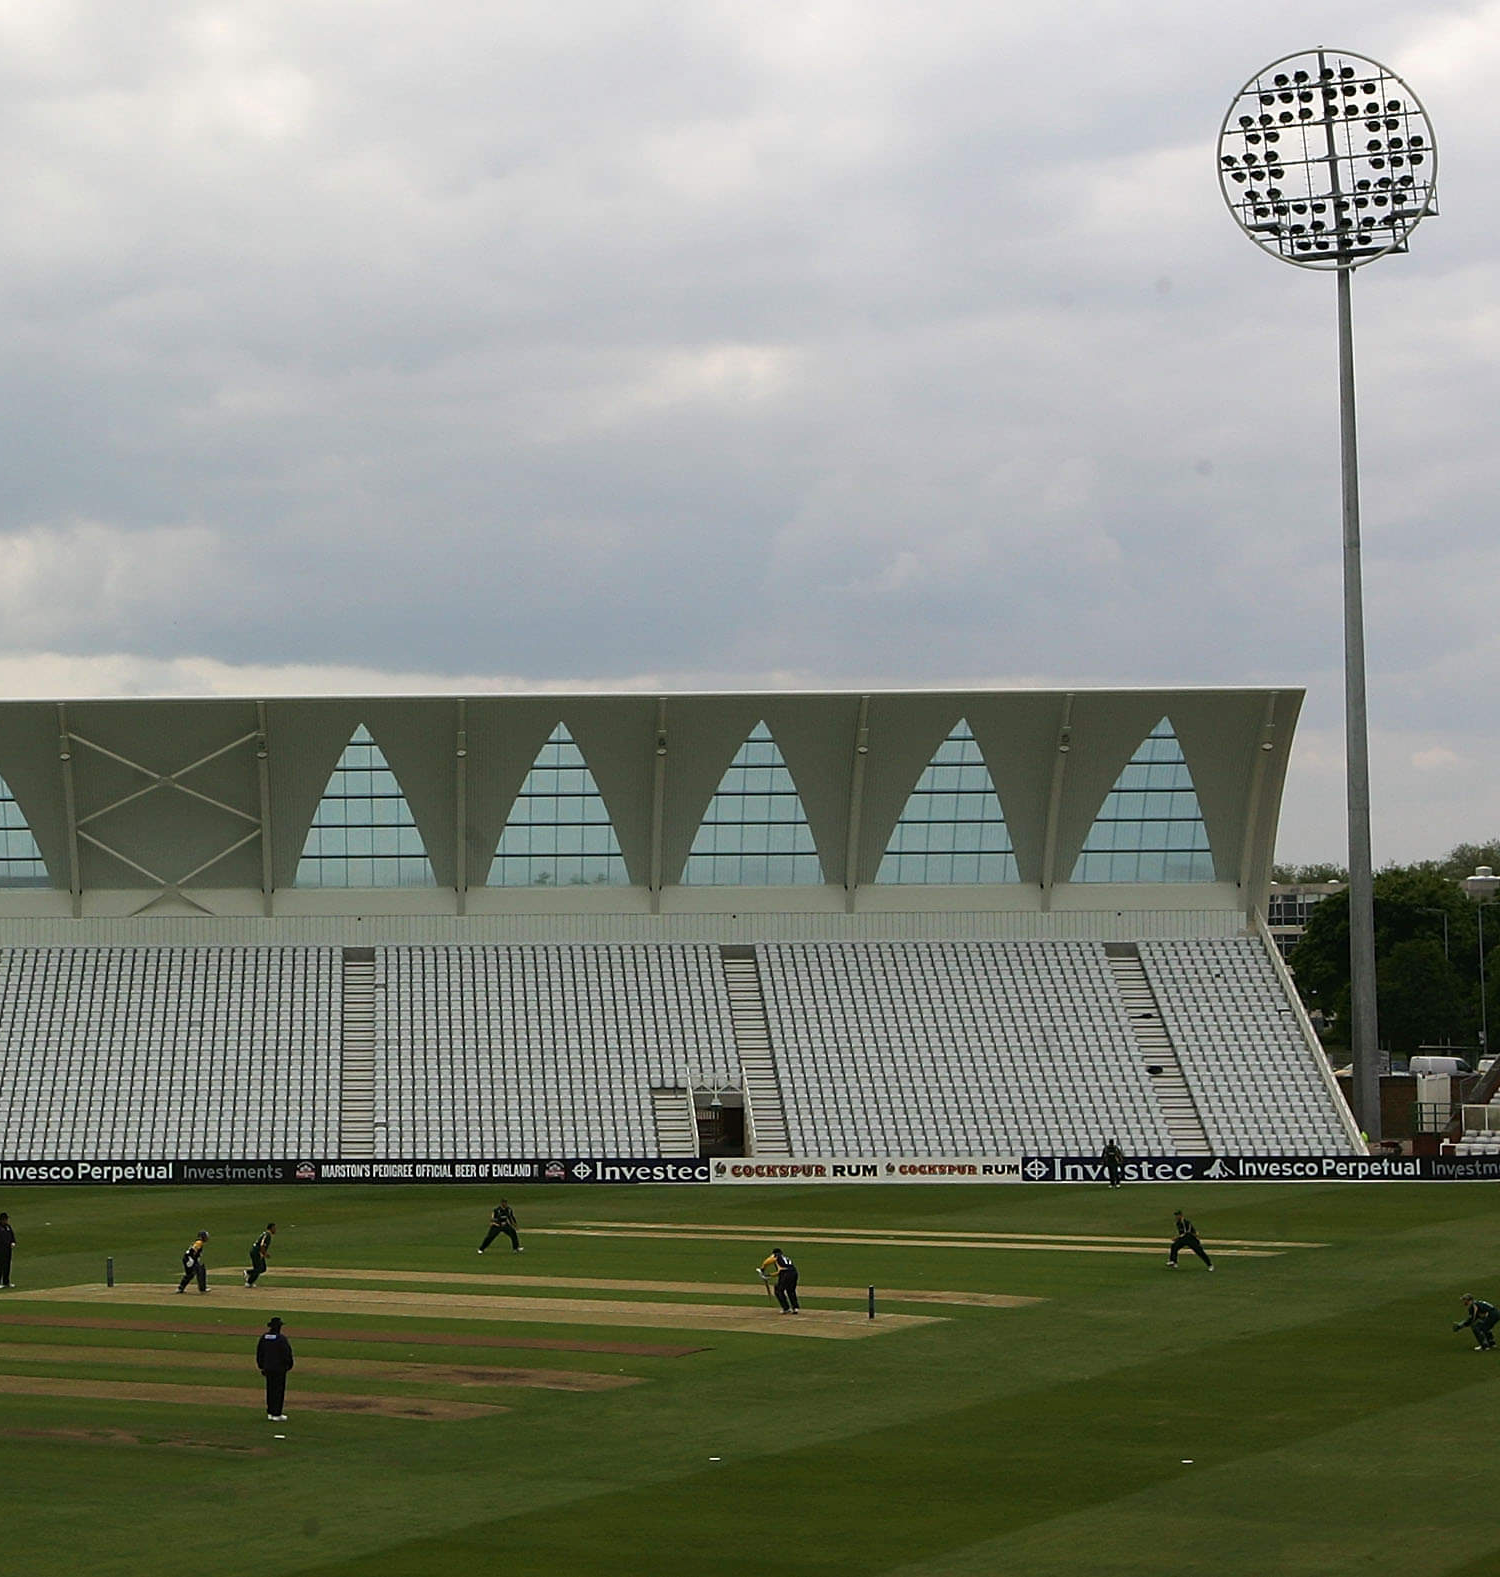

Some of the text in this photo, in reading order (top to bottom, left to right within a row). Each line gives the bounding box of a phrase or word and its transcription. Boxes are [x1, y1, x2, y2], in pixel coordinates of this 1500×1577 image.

[78, 1162, 173, 1182] Perpetual
[183, 1164, 283, 1179] Investments
[321, 1164, 370, 1178] MARSTON'S
[372, 1164, 413, 1178] PEDIGREE
[416, 1164, 452, 1178] OFFICIAL
[455, 1164, 477, 1178] BEER
[479, 1164, 490, 1177] OF
[492, 1164, 531, 1177] ENGLAND
[596, 1162, 708, 1180] Investec
[731, 1164, 1020, 1178] COCKSPUR RUM COCKSPUR RUM
[1239, 1158, 1500, 1179] Invesco Perpetual Investm
